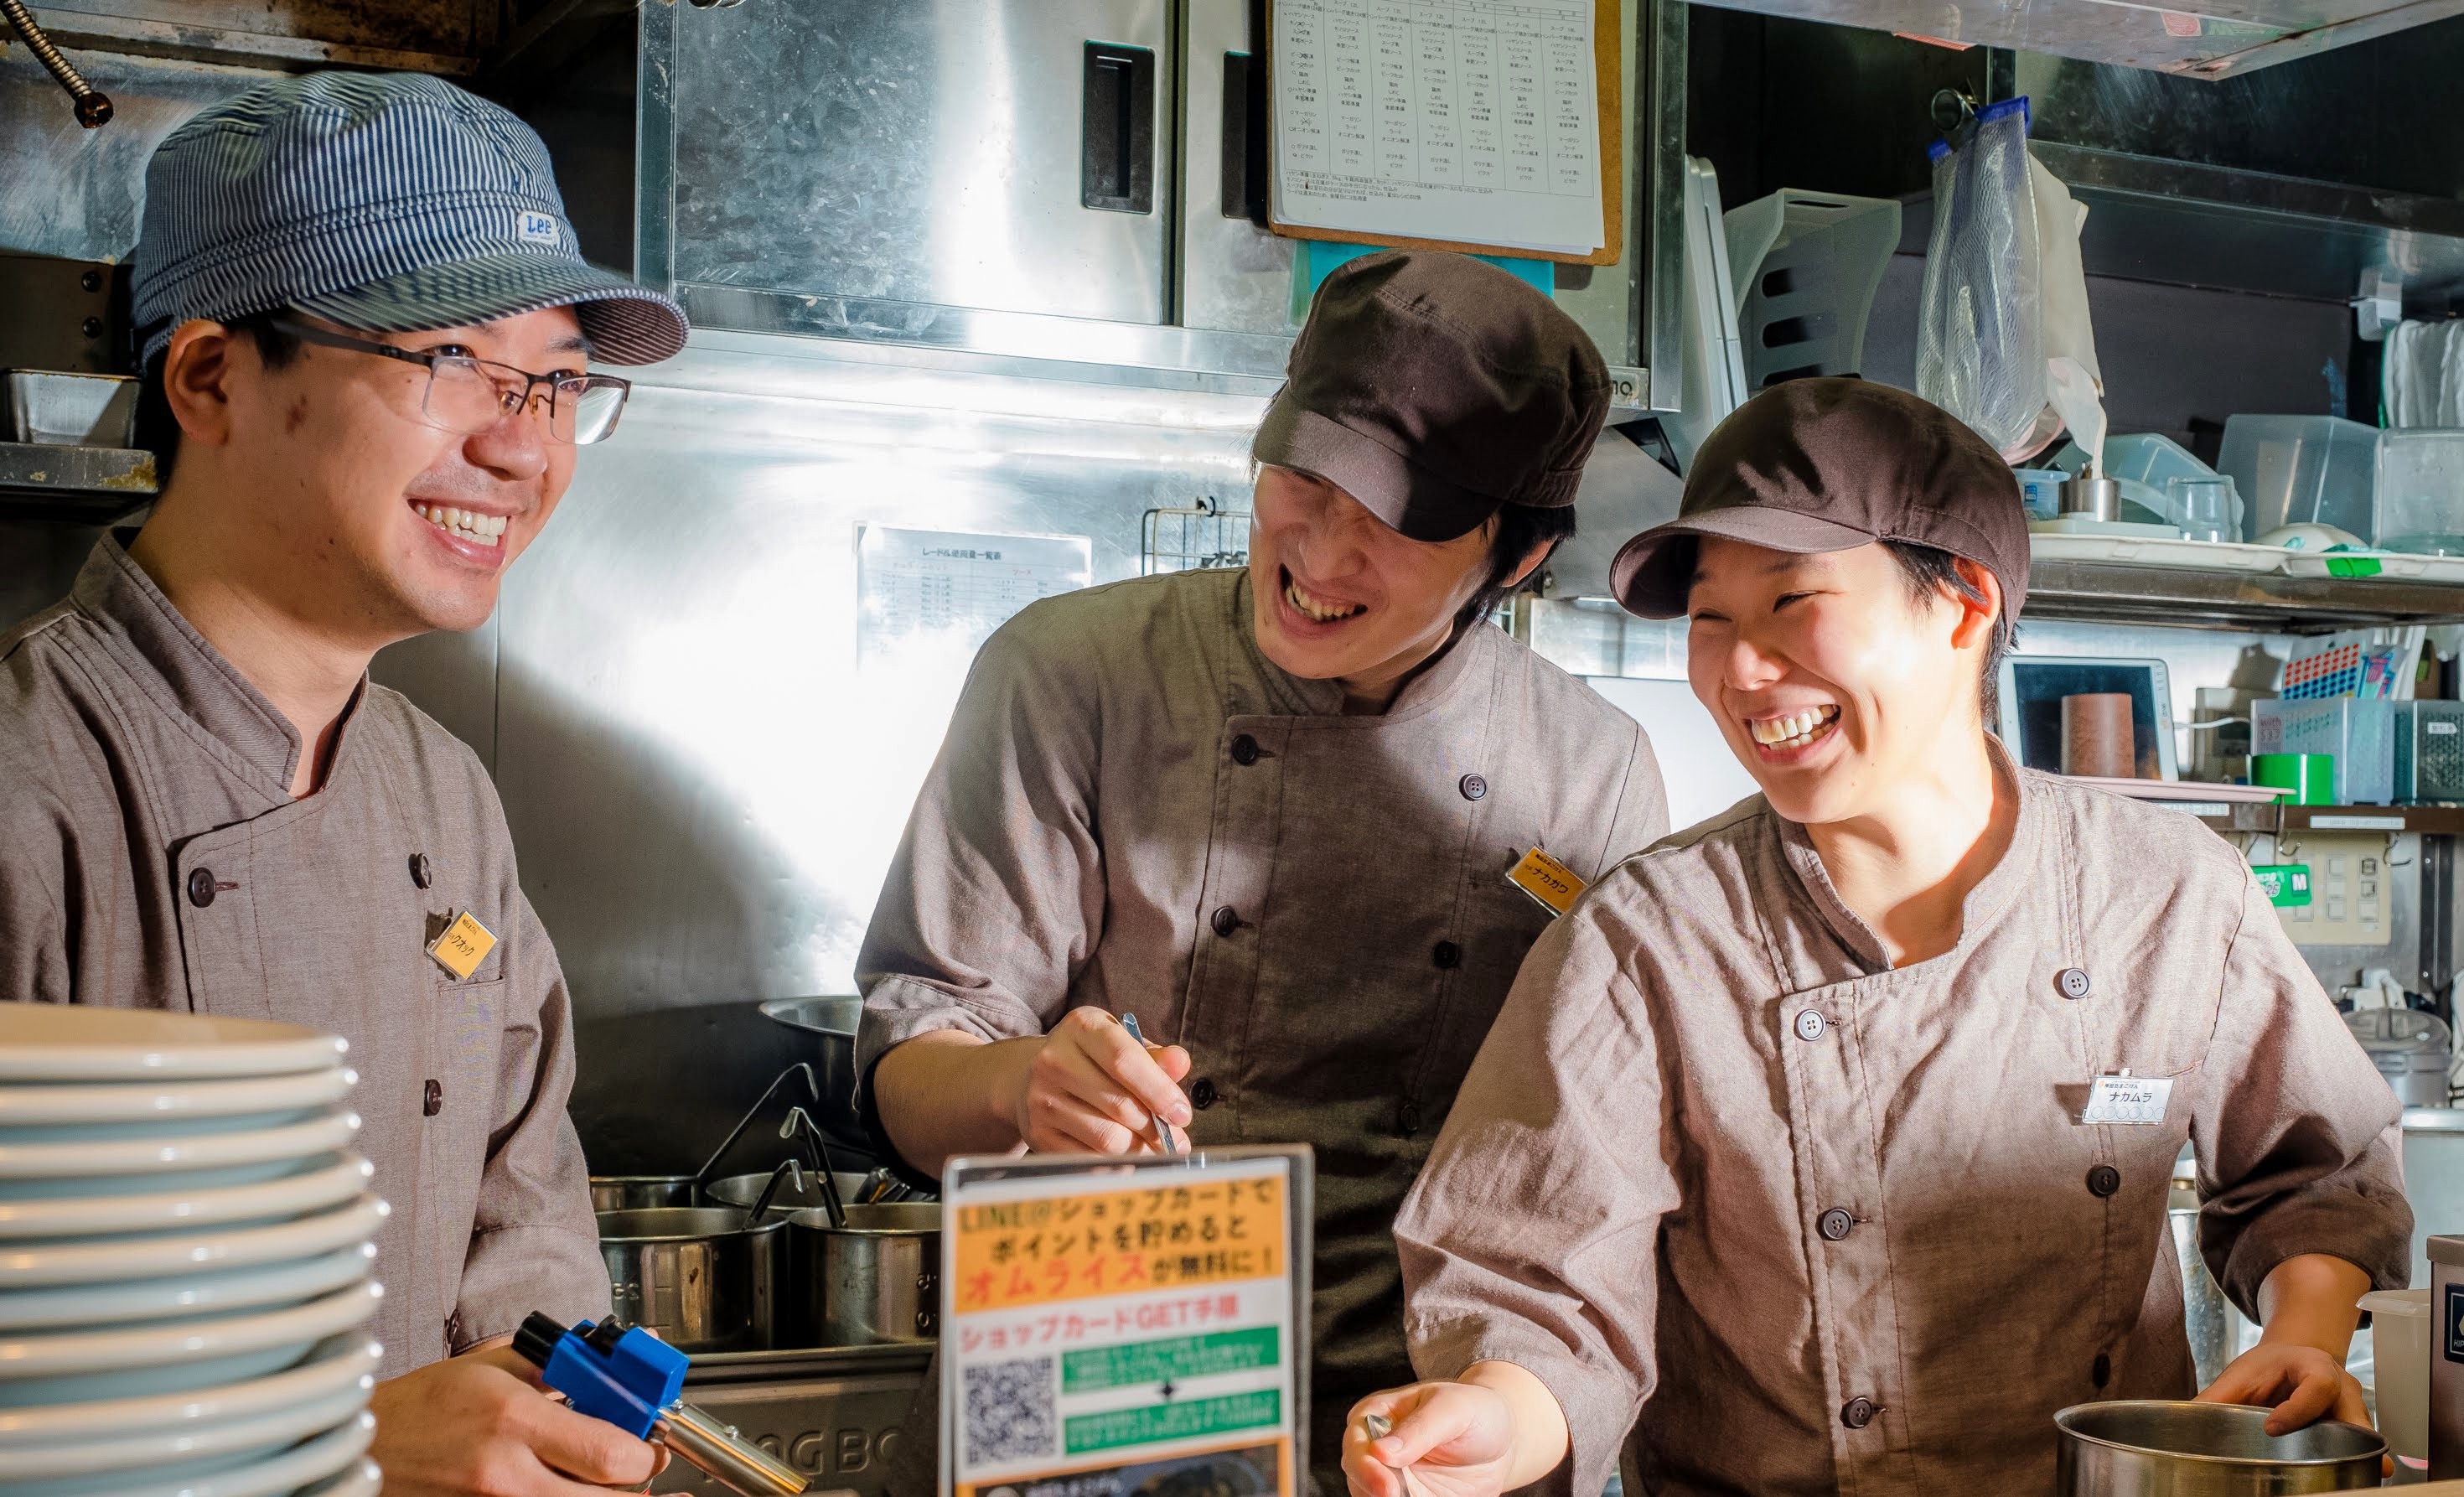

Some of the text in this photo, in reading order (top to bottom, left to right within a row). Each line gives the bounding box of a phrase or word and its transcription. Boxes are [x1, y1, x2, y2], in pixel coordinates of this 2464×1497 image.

[526, 215, 551, 235] Lee
[1532, 868, 1569, 894] ナカガワ
[2109, 1091, 2153, 1103] ナカムラ
[991, 1215, 1248, 1262] ポイントを貯めると
